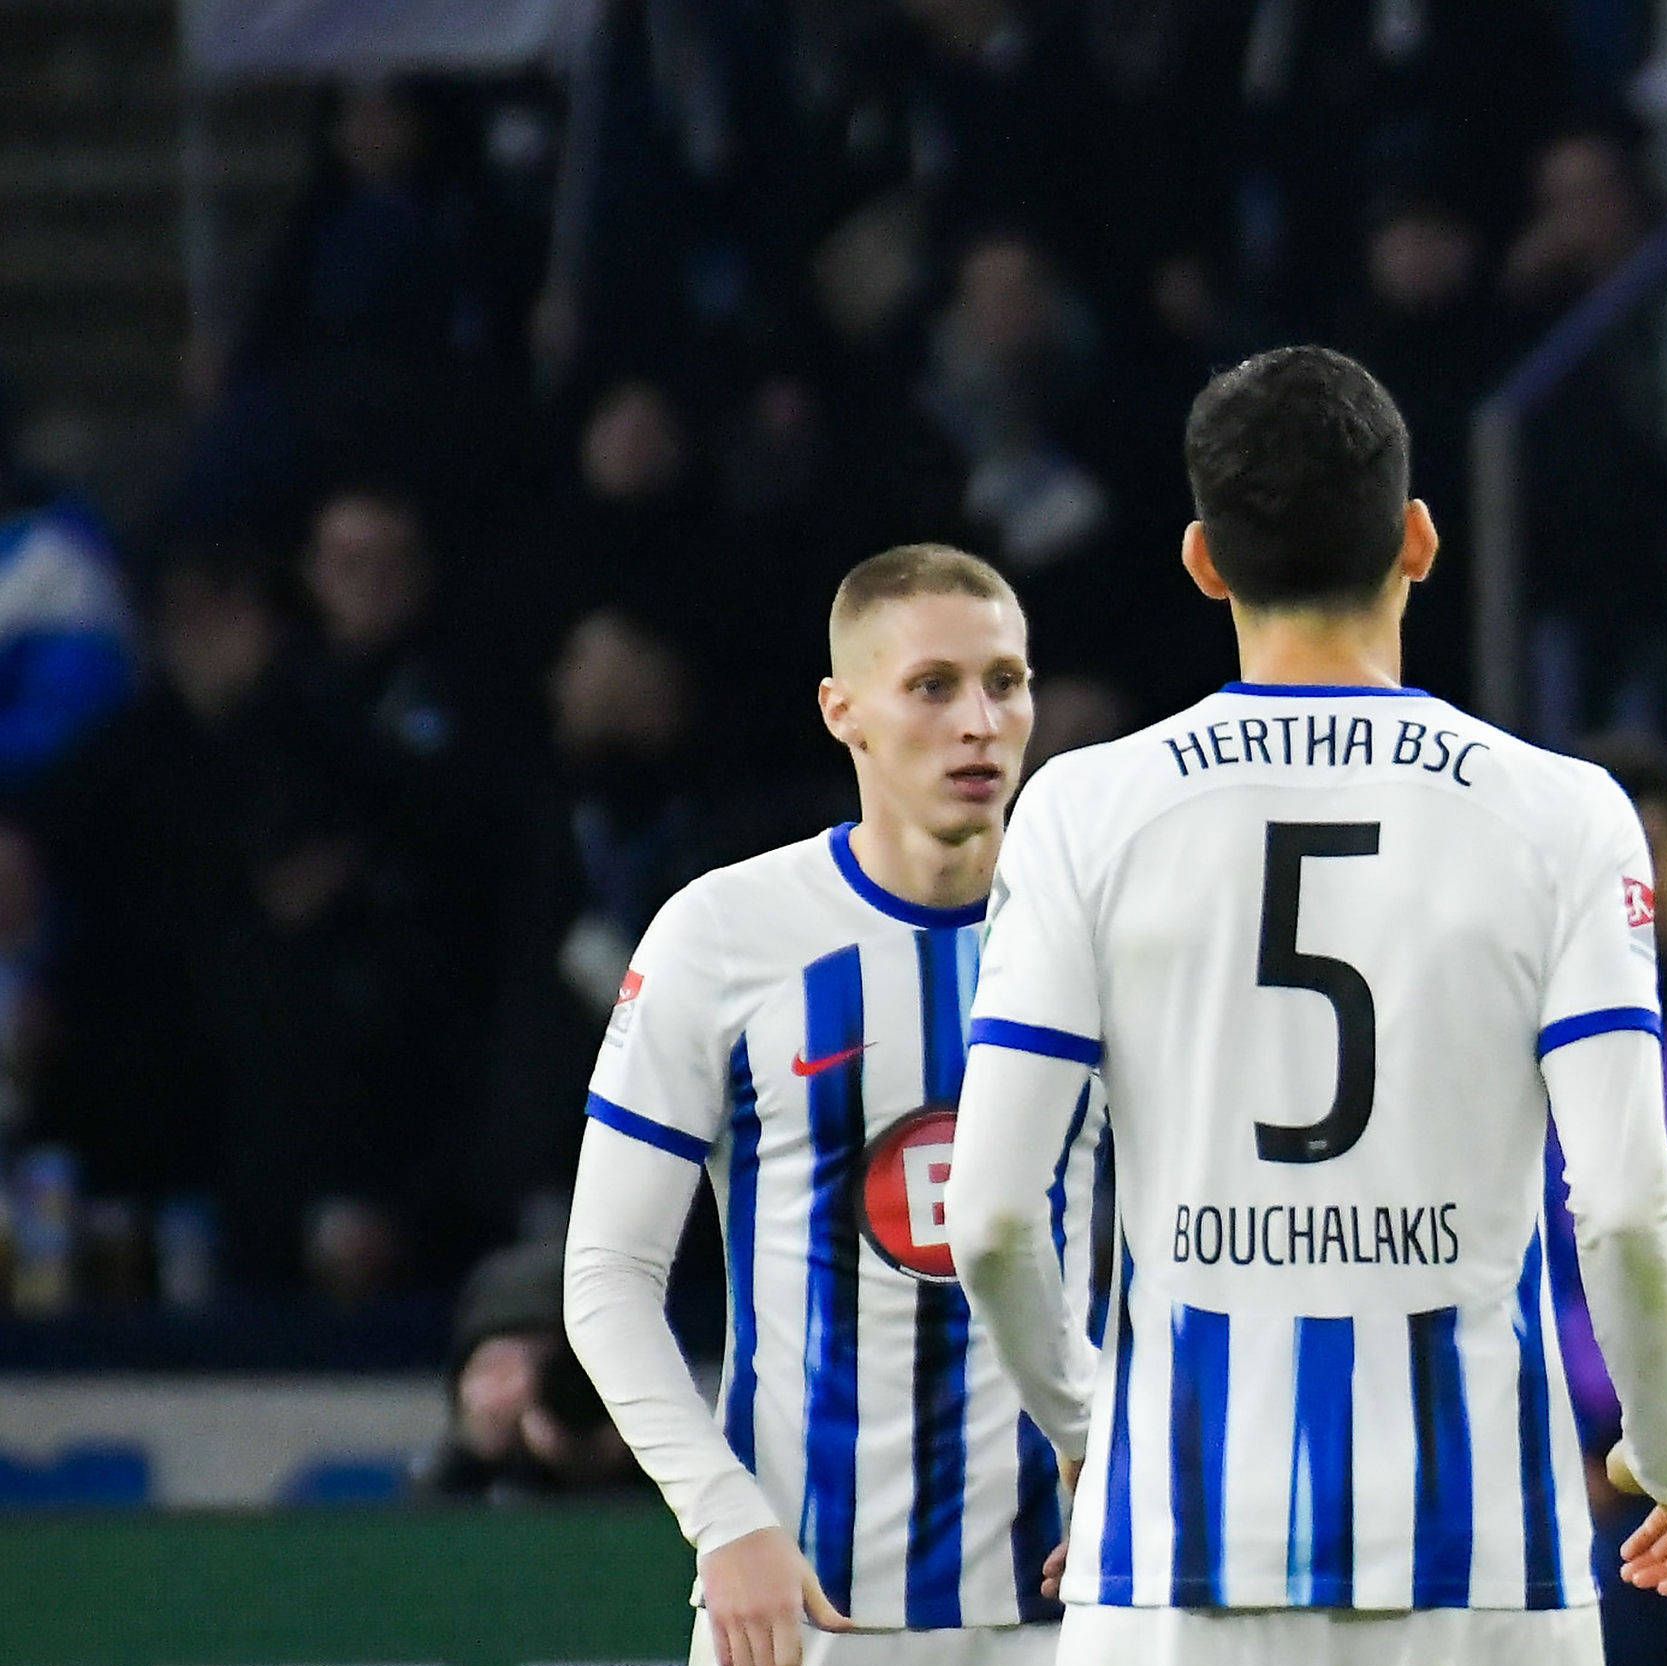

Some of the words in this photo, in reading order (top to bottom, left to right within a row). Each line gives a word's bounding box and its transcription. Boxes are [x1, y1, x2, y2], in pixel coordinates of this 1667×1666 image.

[1162, 714, 1374, 777] HERTHA
[1391, 719, 1491, 787] BSC
[1253, 820, 1381, 1164] 5
[1173, 1202, 1459, 1265] BOUCHALAKIS
